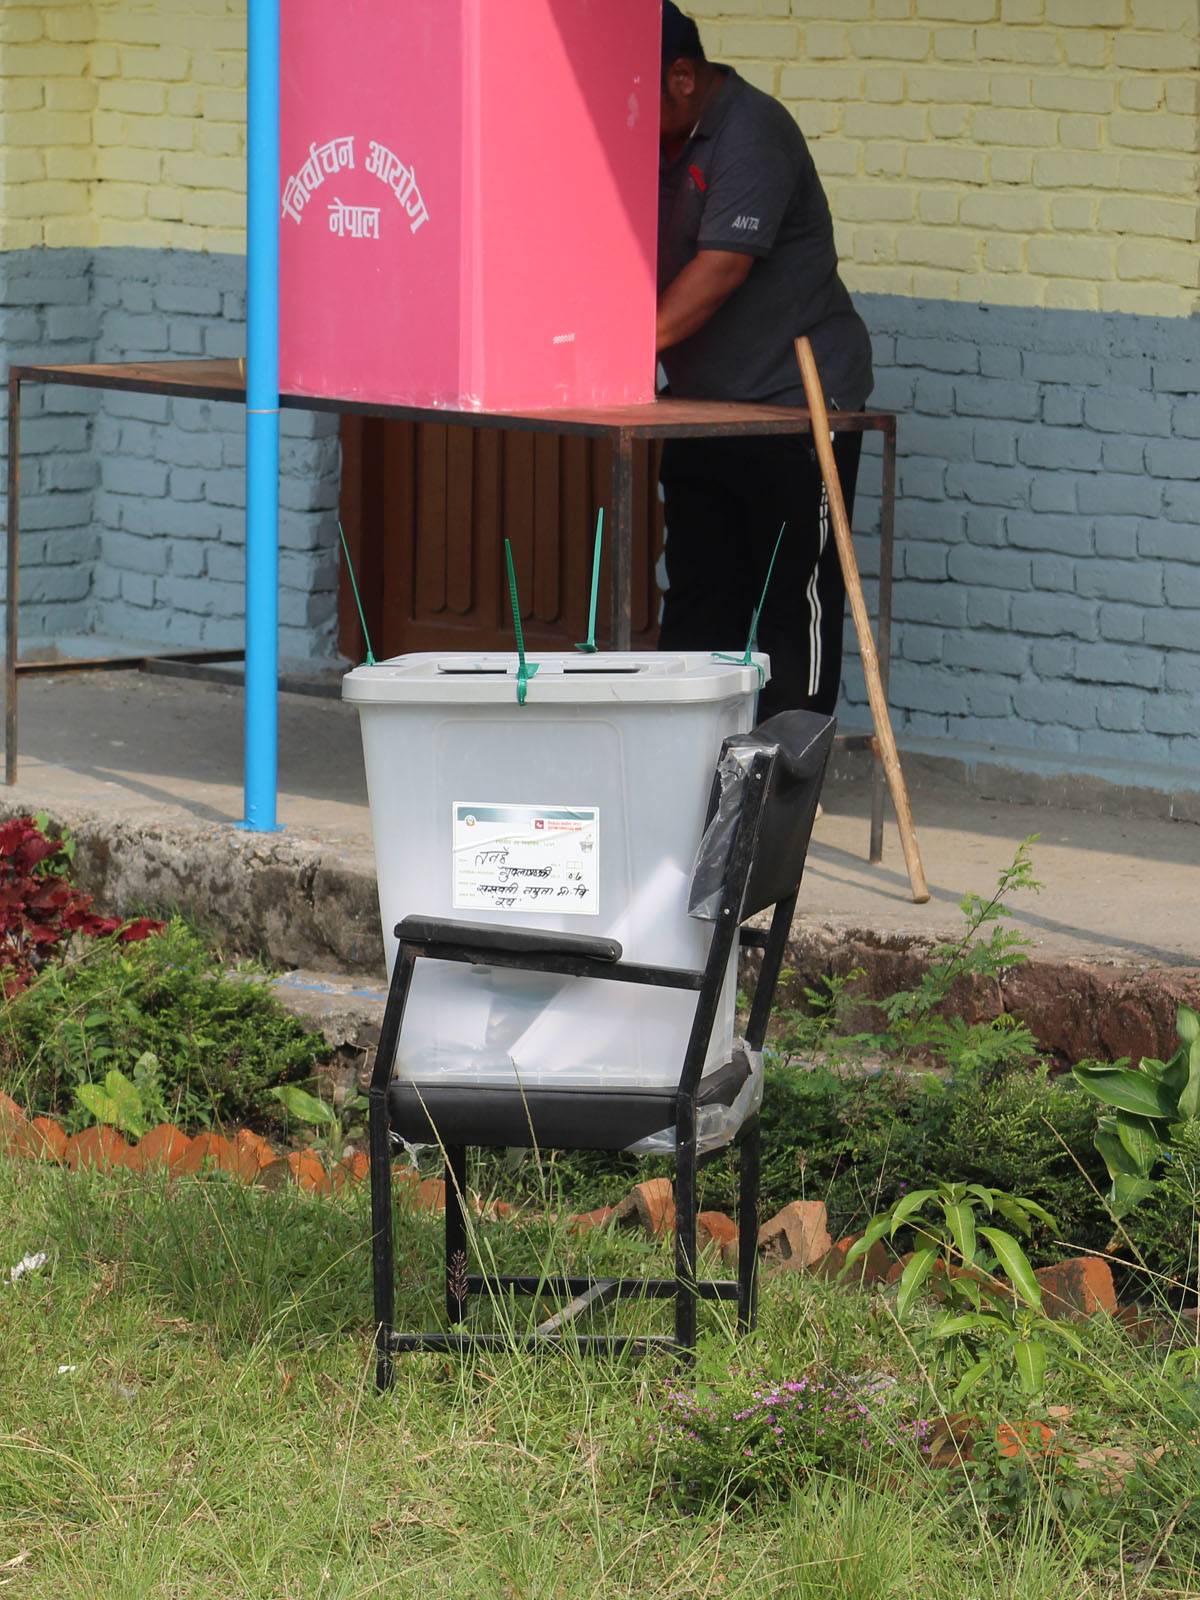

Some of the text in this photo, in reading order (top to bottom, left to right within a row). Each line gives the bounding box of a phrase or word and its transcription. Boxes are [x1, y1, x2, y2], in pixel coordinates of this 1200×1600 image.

[281, 136, 430, 234] निर्वाचन आयोग
[328, 197, 381, 240] नेपाल
